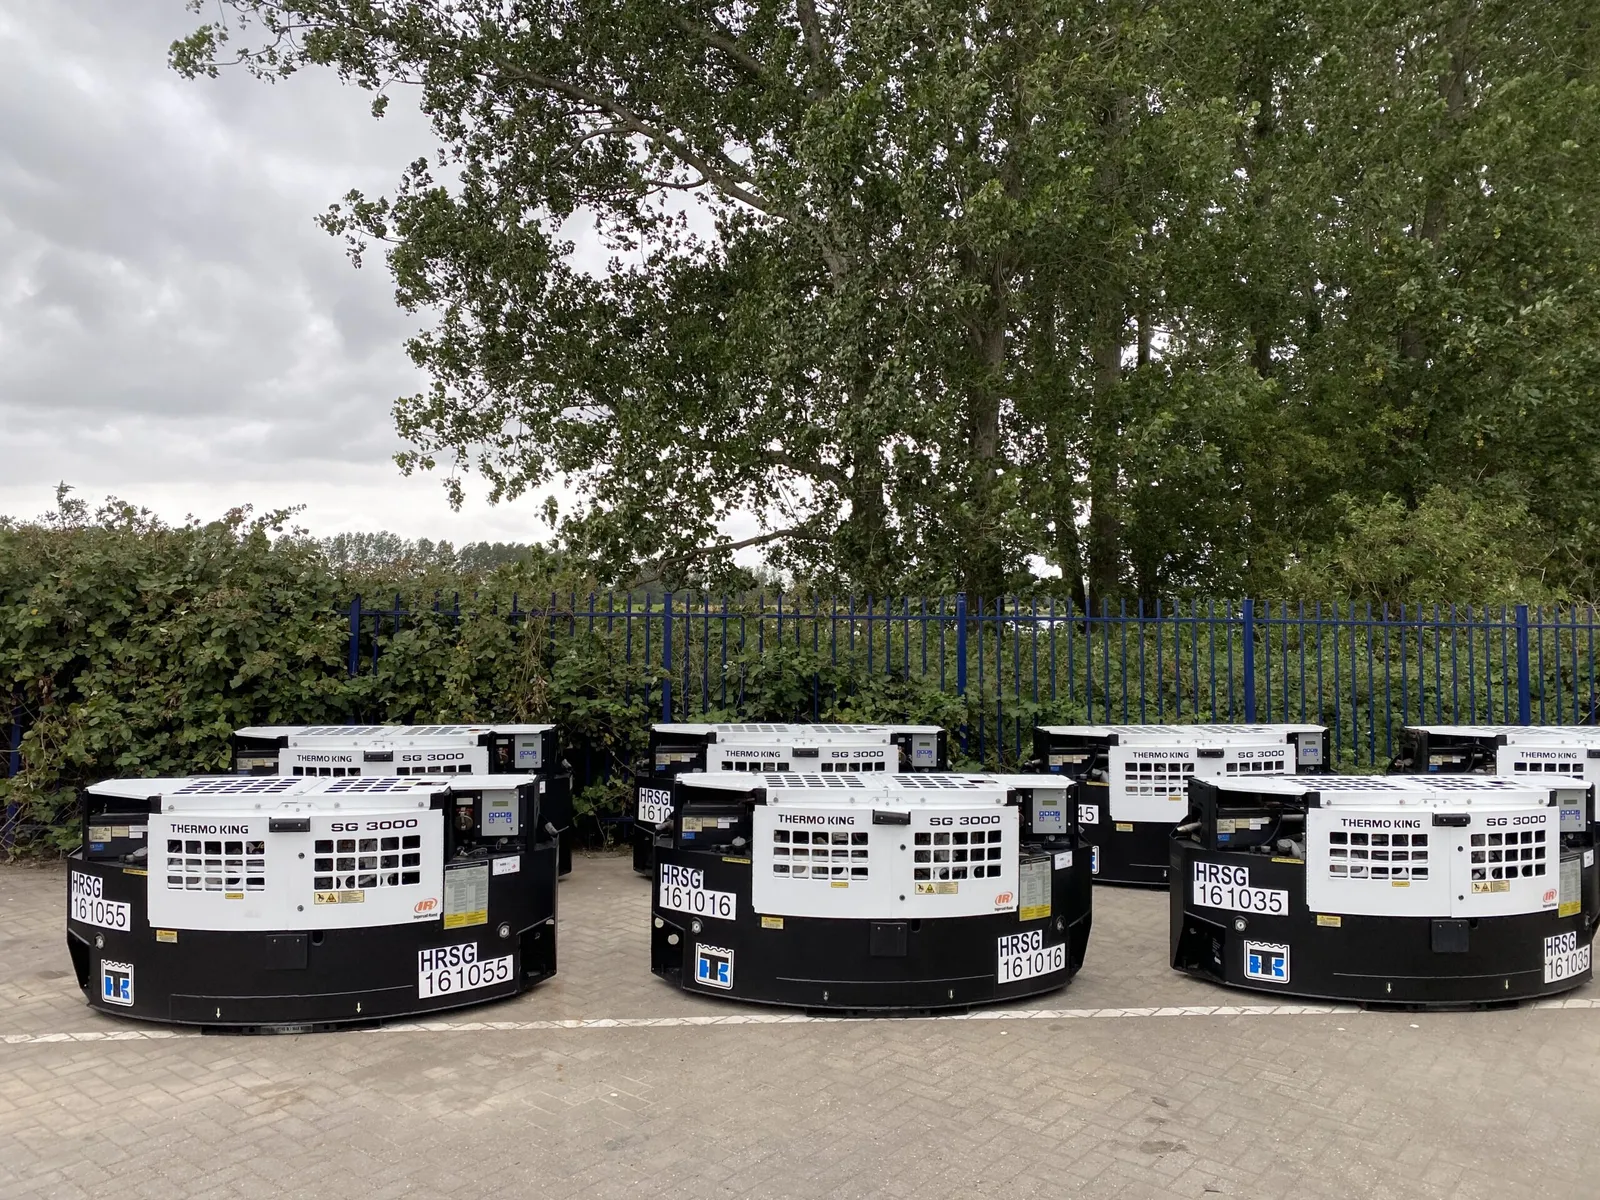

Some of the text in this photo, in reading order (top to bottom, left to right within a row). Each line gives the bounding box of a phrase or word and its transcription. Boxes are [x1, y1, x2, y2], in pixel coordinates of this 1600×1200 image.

[297, 754, 352, 763] THERMO KING
[402, 753, 465, 762] SG 3000
[853, 750, 884, 758] 3000
[1133, 751, 1168, 759] THERMO
[1237, 750, 1285, 759] SG 3000
[641, 788, 669, 806] HRSG
[331, 819, 418, 832] SG 3000
[778, 814, 855, 825] THERMO KING
[929, 816, 1001, 826] SG 3000
[1341, 818, 1421, 829] THERMO KING
[1486, 815, 1547, 826] SG 3000
[170, 823, 249, 834] THERMO KING
[661, 866, 701, 889] HRSG
[1195, 863, 1247, 887] HRSG
[72, 872, 101, 899] HRSG
[664, 885, 731, 916] 161016
[997, 894, 1011, 903] IR
[1199, 883, 1282, 913] 161035
[74, 898, 126, 928] 161055
[417, 901, 434, 911] IR
[1000, 932, 1040, 958] HRSG
[1546, 932, 1576, 958] HRSG
[420, 944, 475, 972] HRSG
[1003, 948, 1062, 980] 161016
[1548, 948, 1589, 980] 161035
[426, 958, 508, 994] 161055
